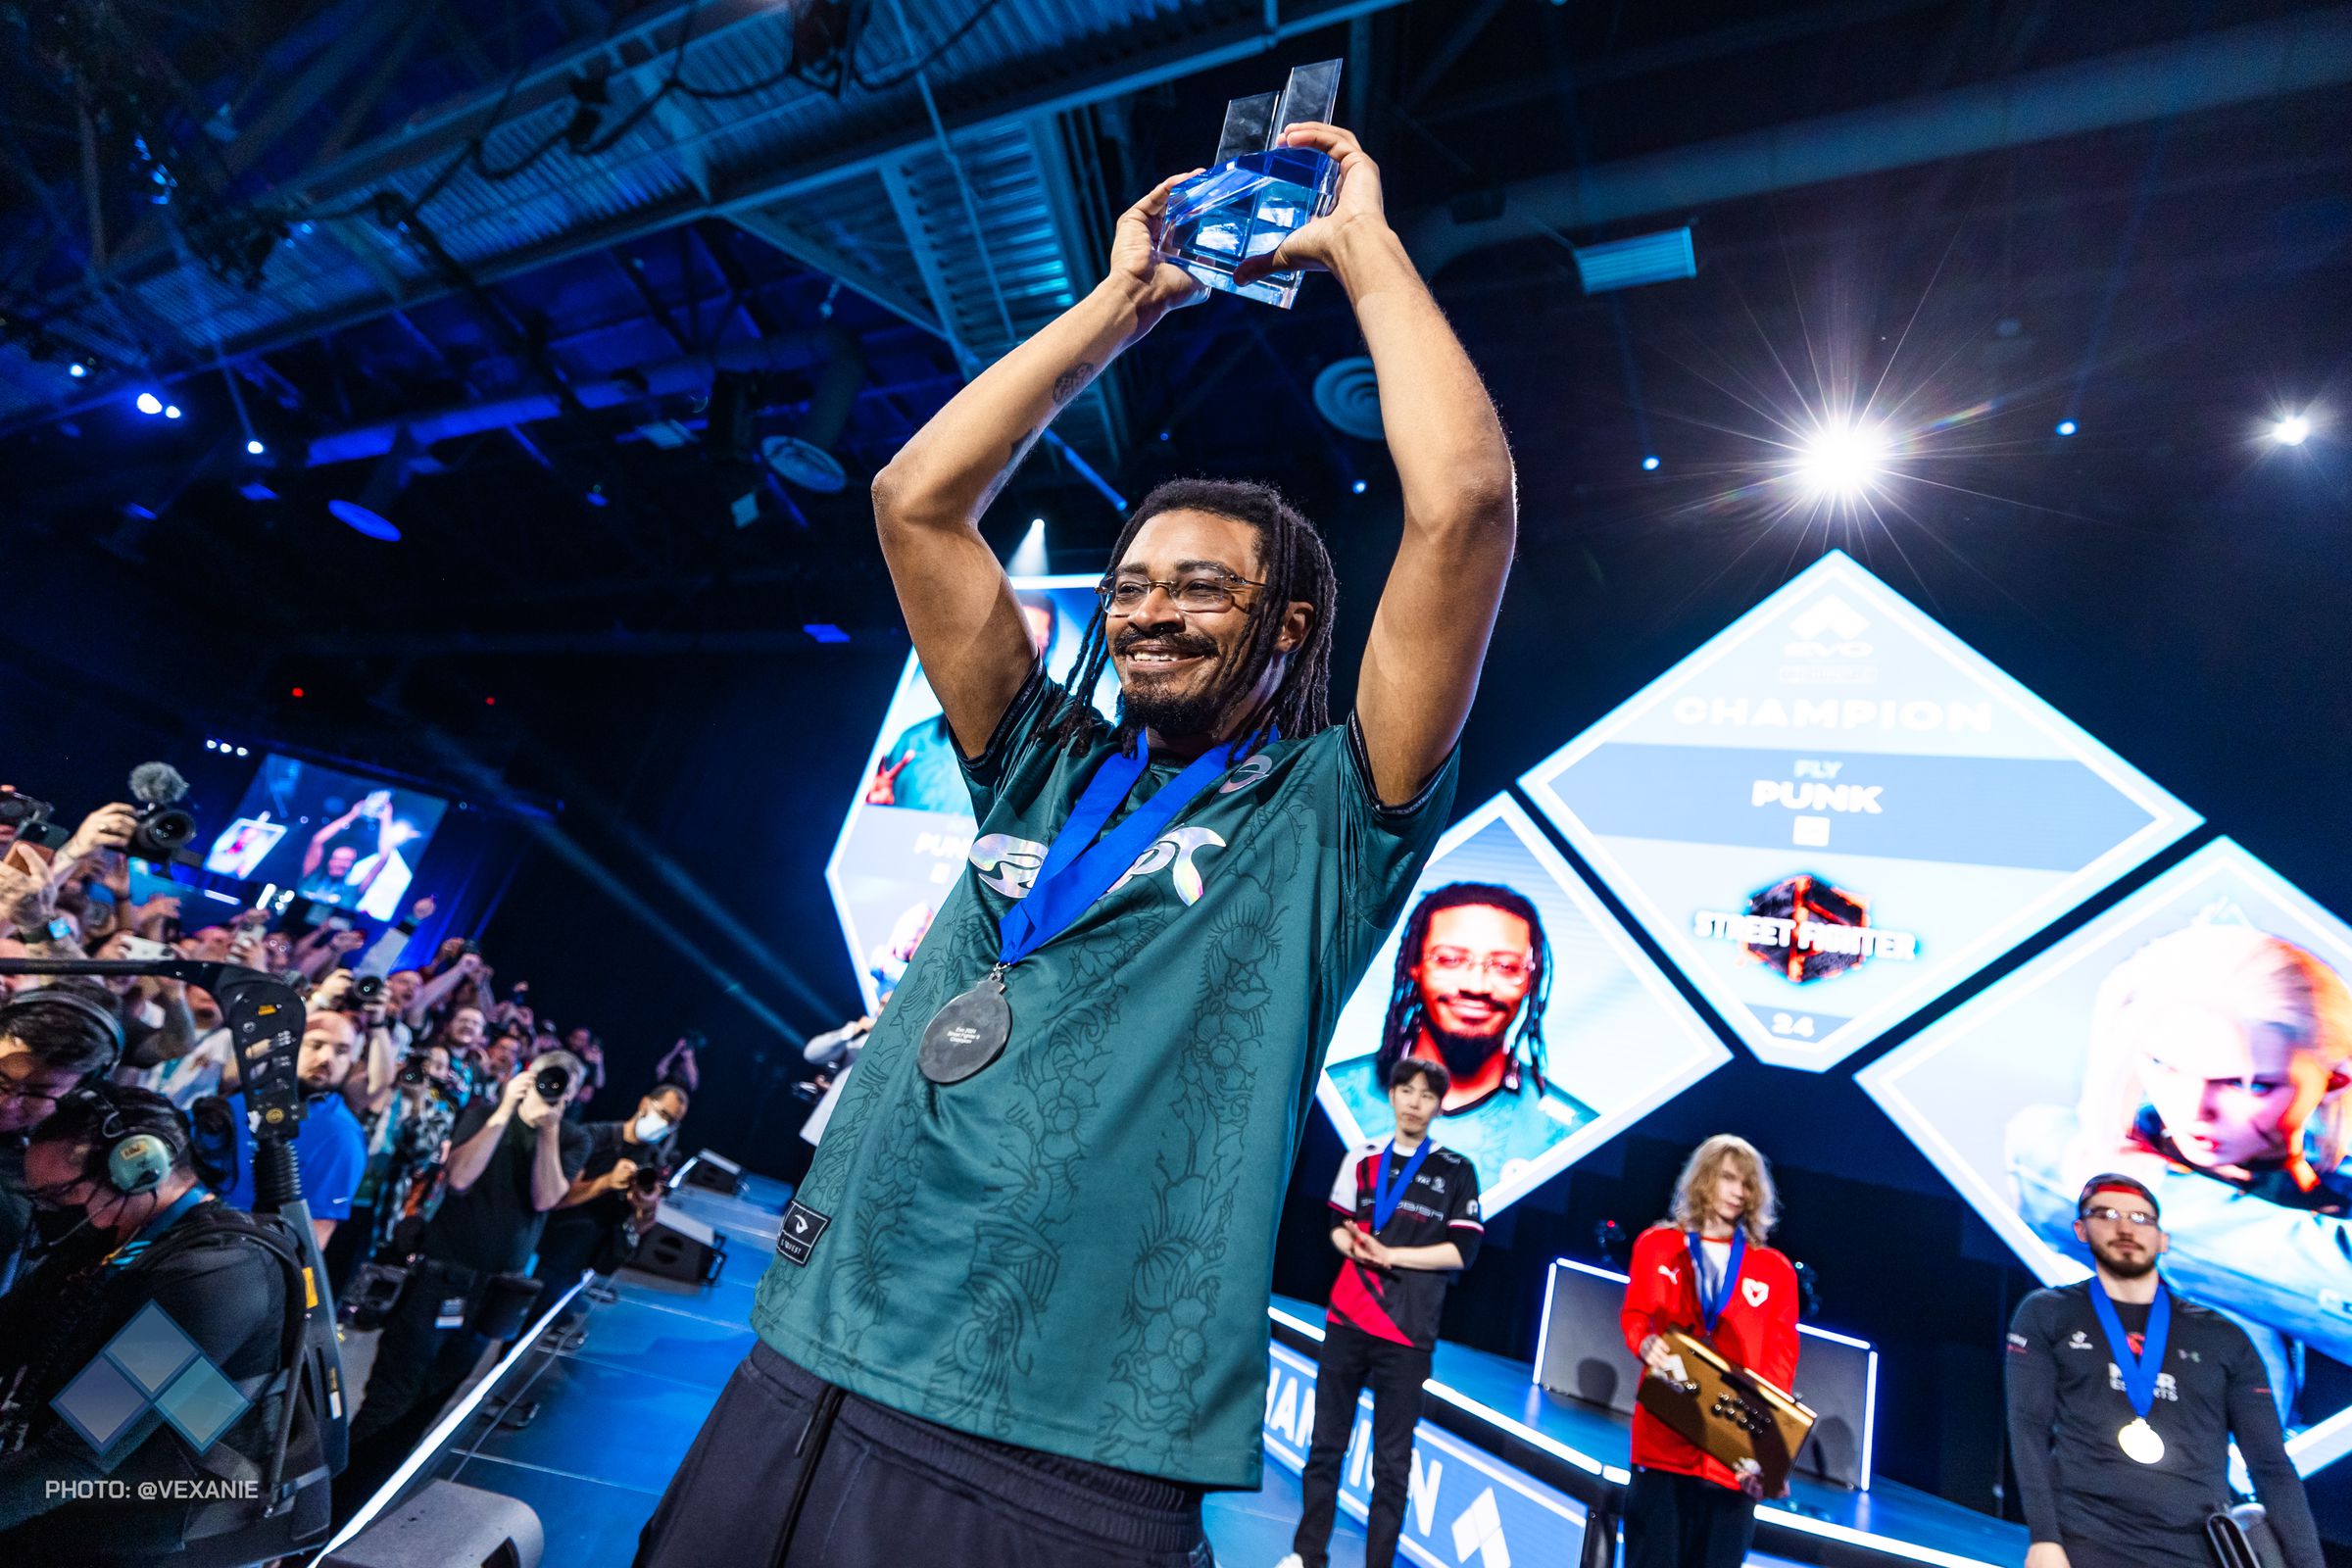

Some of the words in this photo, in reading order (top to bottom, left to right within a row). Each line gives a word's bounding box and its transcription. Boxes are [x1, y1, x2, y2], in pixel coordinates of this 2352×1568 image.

[1673, 696, 1993, 733] CHAMPION
[1793, 759, 1843, 779] FLY
[1751, 780, 1884, 814] PUNK
[1694, 910, 1796, 948] STREET
[1797, 921, 1918, 961] FIGHTER
[1772, 1012, 1815, 1039] 24
